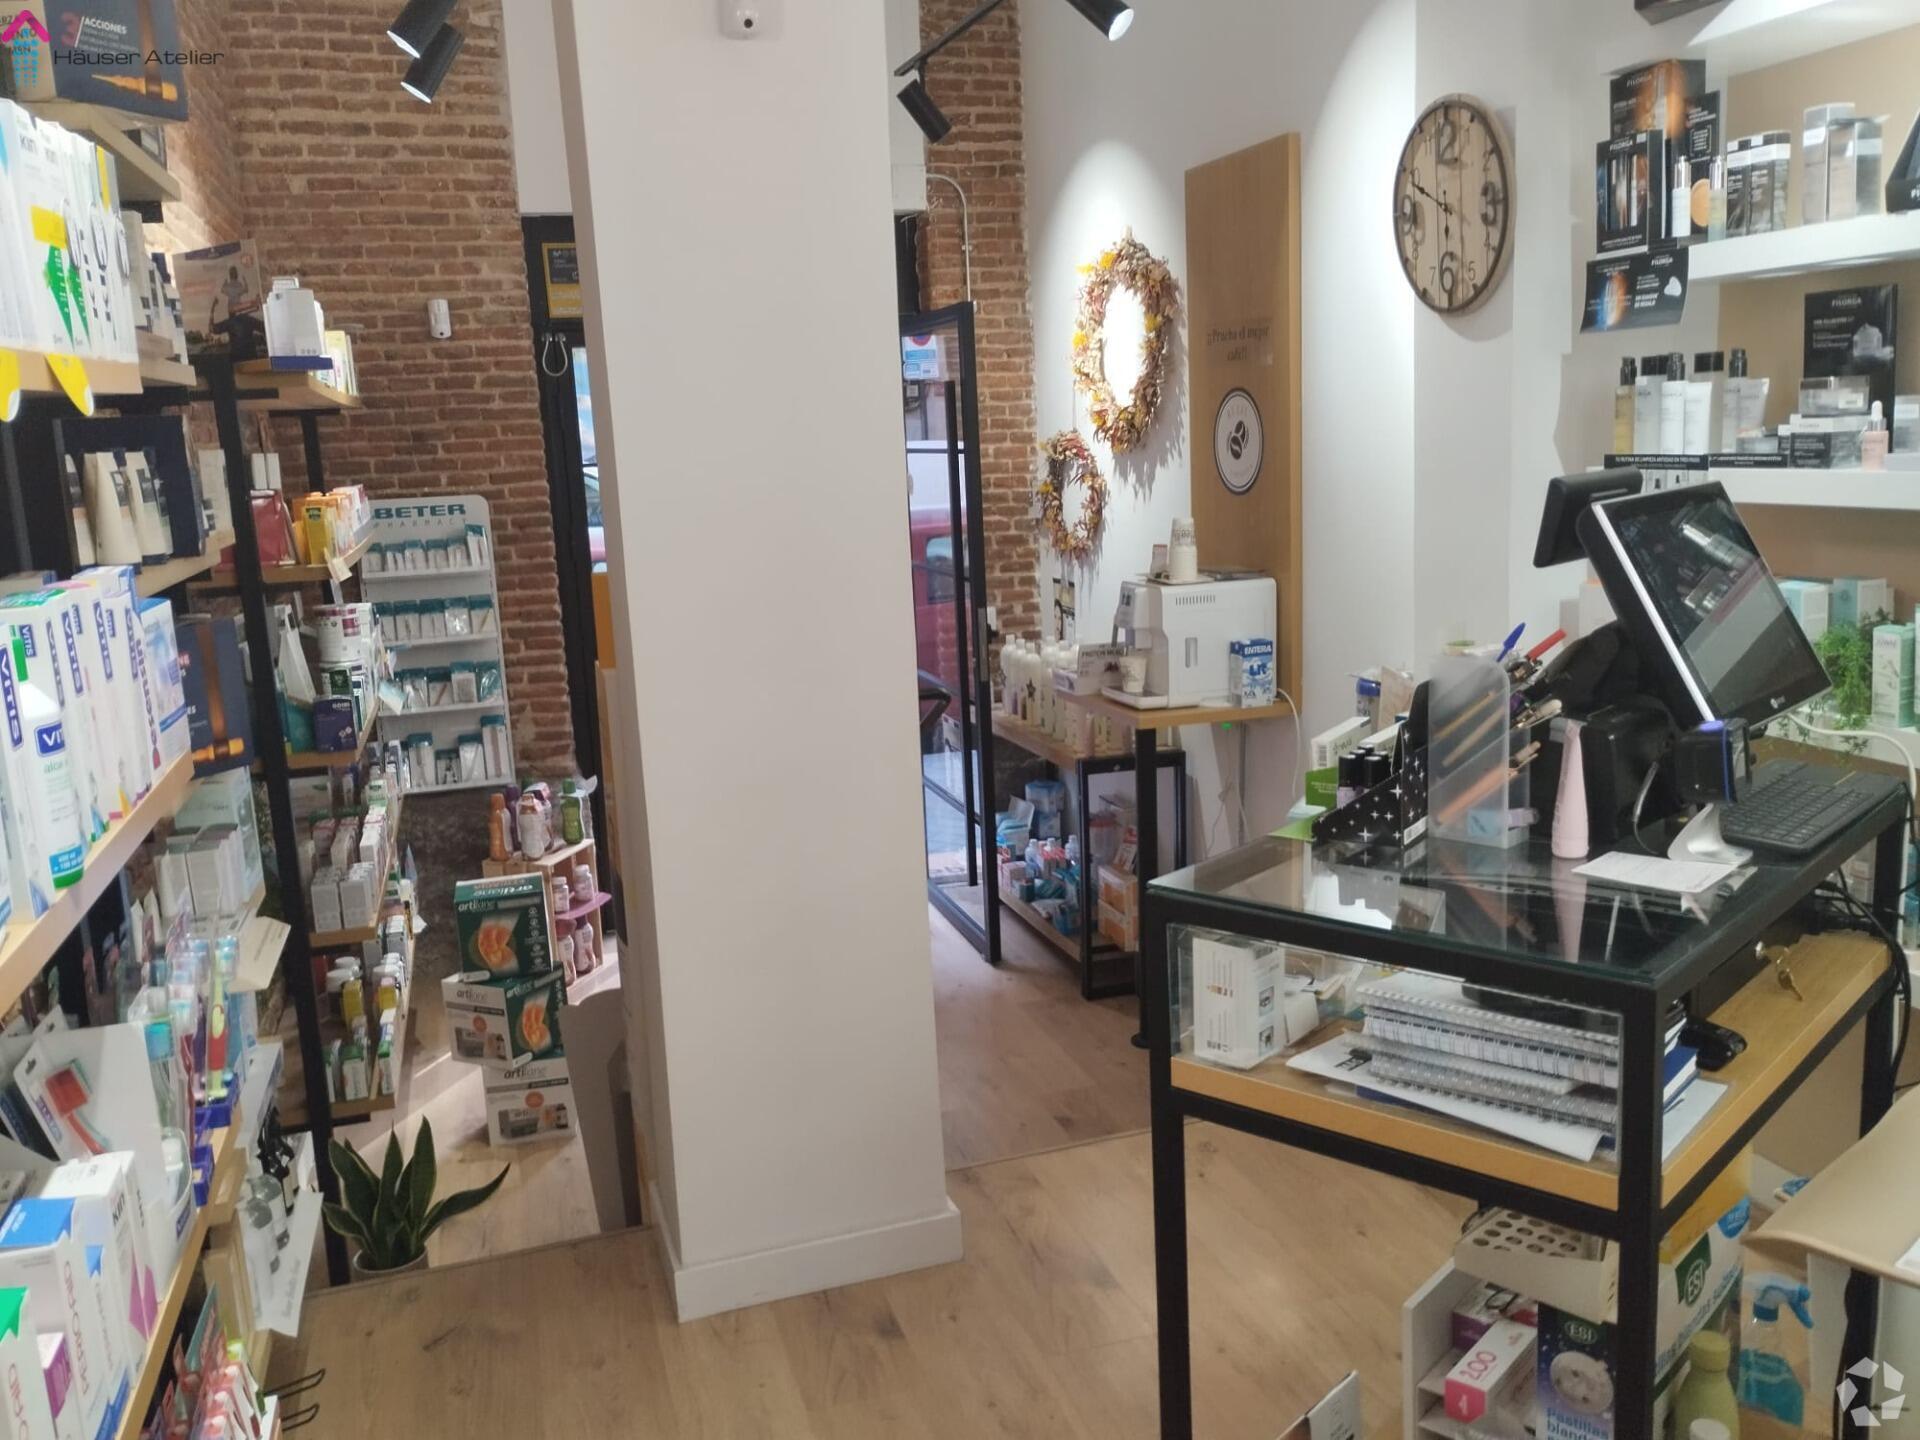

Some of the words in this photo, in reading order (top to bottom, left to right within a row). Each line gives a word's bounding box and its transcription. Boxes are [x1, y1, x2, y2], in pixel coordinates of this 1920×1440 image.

[84, 16, 128, 36] ACCIONES
[1437, 114, 1459, 165] 12
[1439, 250, 1455, 294] 6
[373, 503, 466, 519] BETER
[64, 615, 82, 691] VITIS
[1244, 645, 1272, 656] ENTERA
[0, 652, 21, 742] VITIS
[1569, 1324, 1593, 1342] ESI
[1459, 1350, 1497, 1380] 200
[1546, 1406, 1609, 1440] Pastillas
